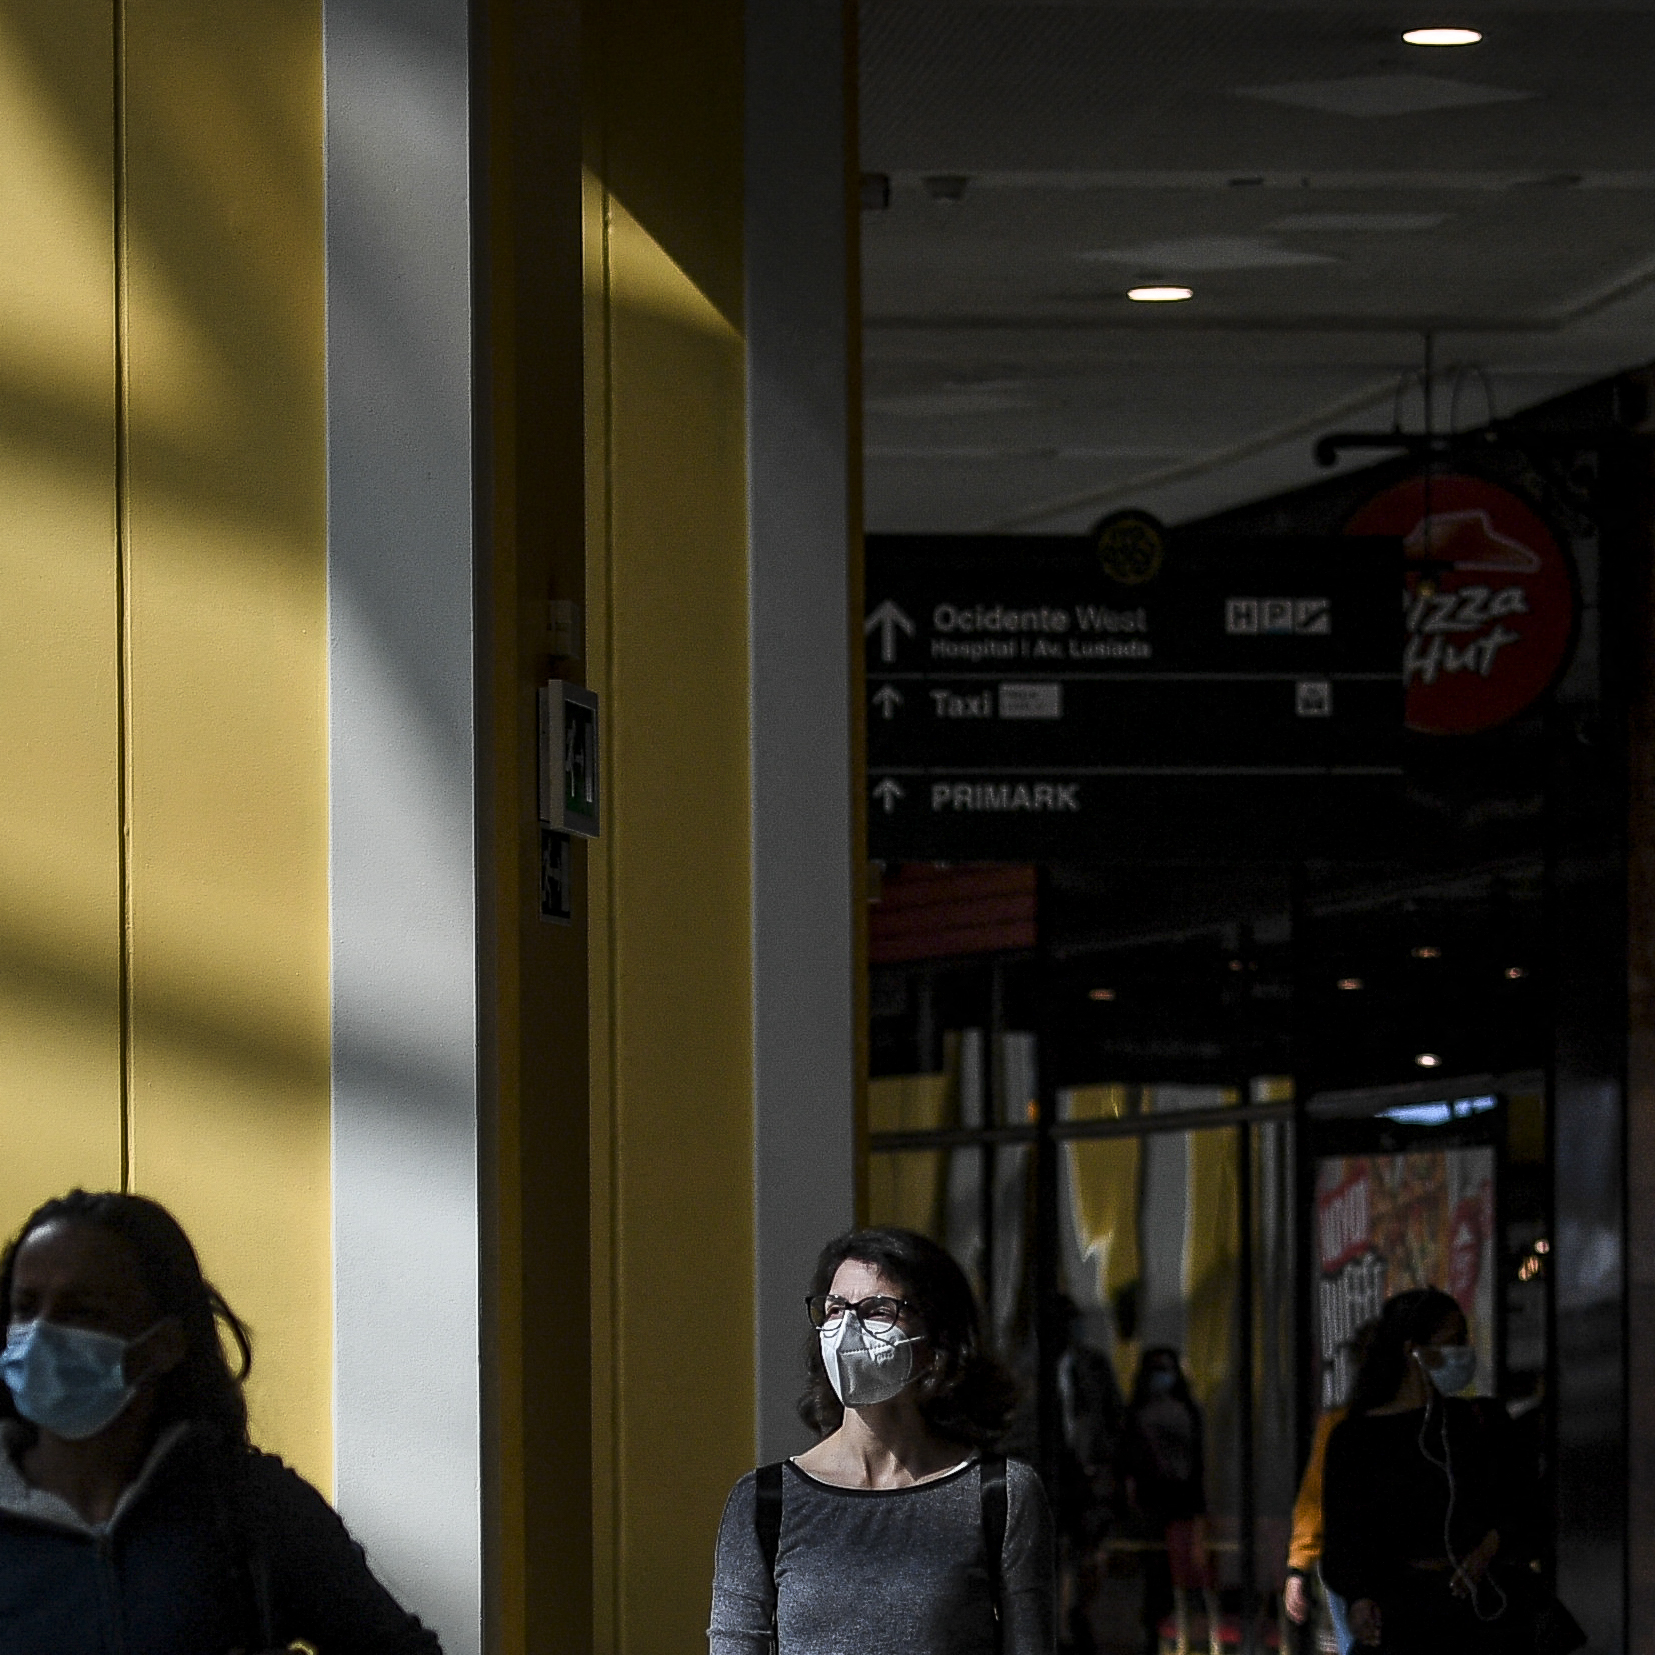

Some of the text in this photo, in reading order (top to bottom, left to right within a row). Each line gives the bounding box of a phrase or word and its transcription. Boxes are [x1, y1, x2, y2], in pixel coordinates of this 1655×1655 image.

[932, 602, 1149, 634] Ocidente West
[1402, 584, 1530, 633] izza
[930, 638, 1017, 662] Hospital
[1402, 623, 1521, 690] Hut
[929, 688, 993, 719] Taxi
[930, 781, 1081, 812] PRIMARK
